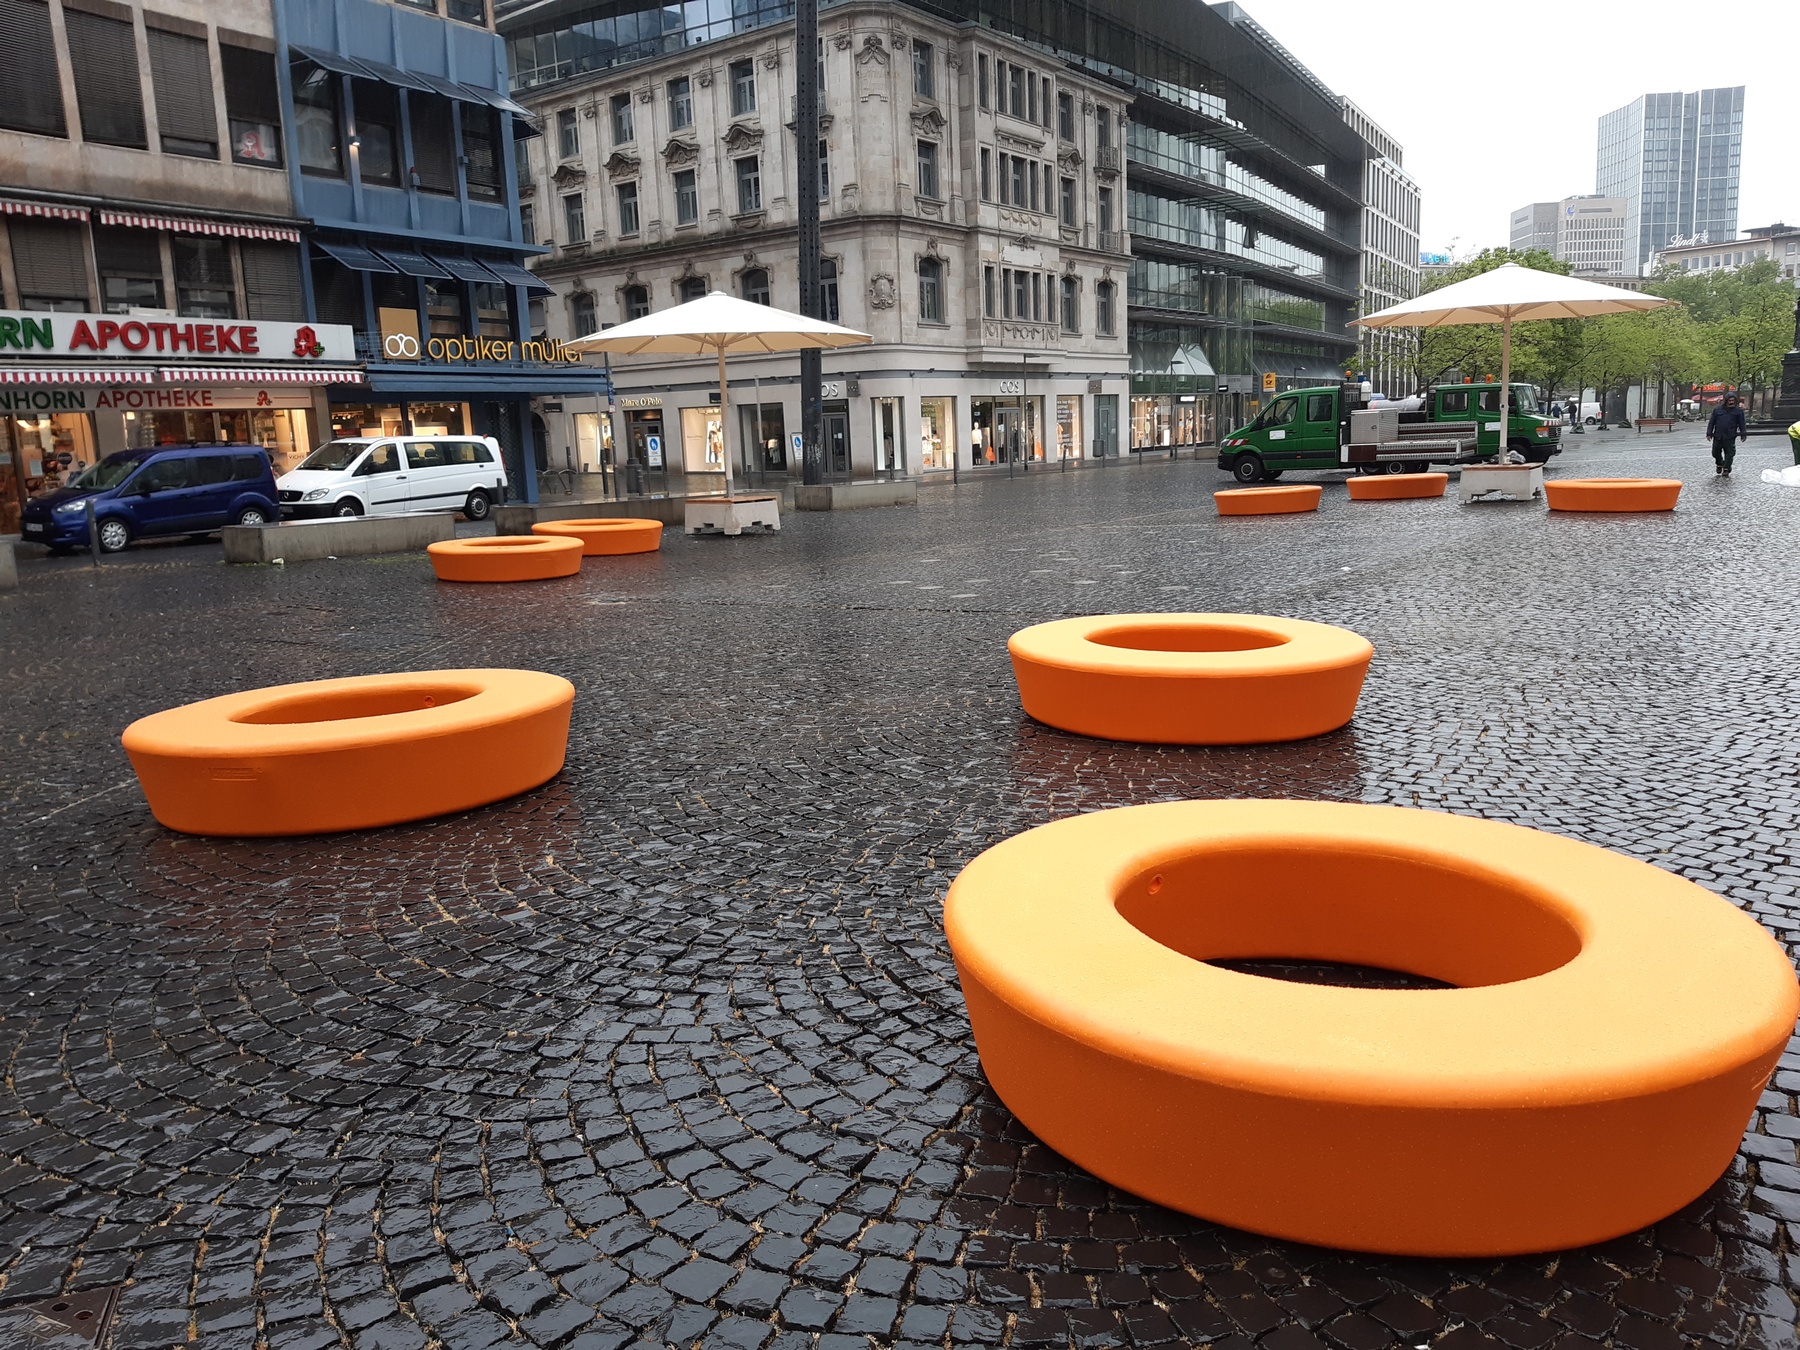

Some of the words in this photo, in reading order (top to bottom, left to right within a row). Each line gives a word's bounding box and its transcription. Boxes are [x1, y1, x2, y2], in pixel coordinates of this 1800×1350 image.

[1667, 233, 1701, 248] Lindt
[69, 320, 259, 353] APOTHEKE
[427, 335, 514, 363] optiker
[1000, 381, 1020, 393] COS
[0, 390, 86, 409] NHORN
[96, 390, 213, 409] APOTHEKE
